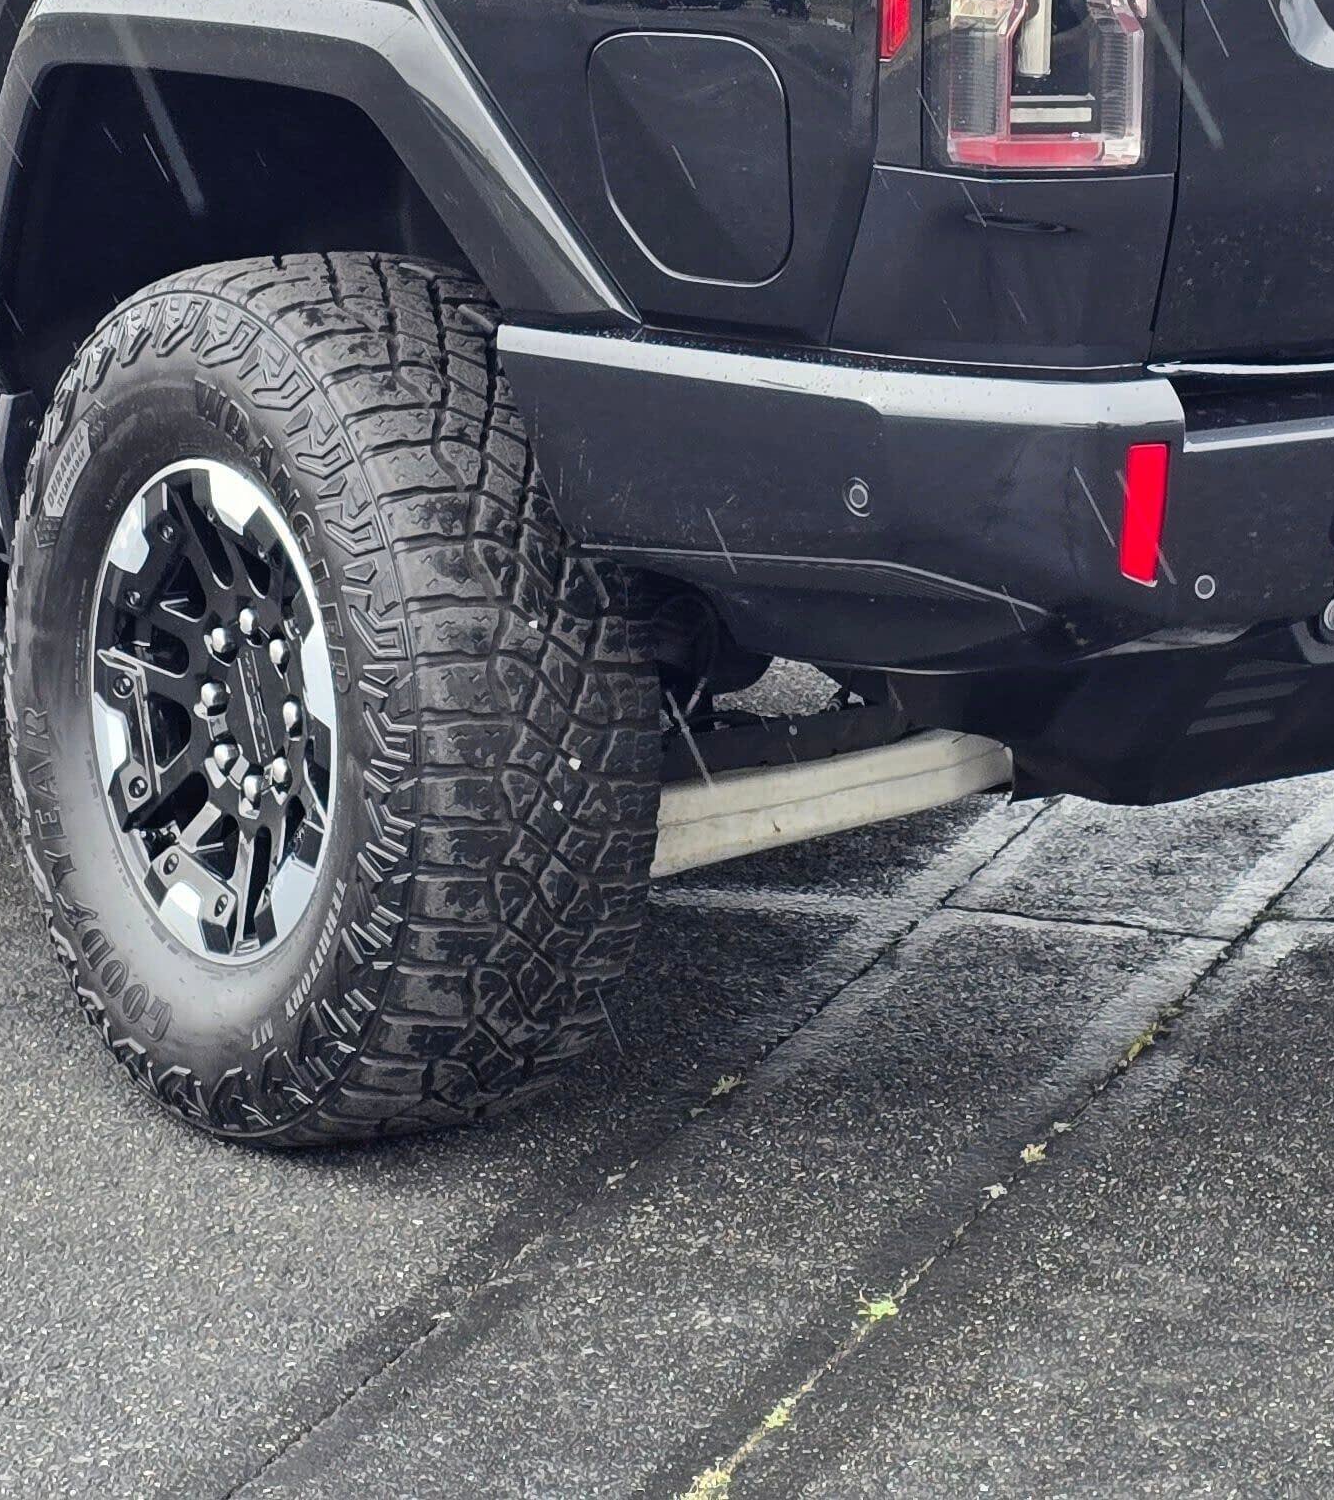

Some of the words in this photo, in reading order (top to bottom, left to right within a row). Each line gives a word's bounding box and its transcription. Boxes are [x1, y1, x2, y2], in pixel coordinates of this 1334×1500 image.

[47, 428, 85, 509] DURAWALL
[57, 449, 86, 508] TECHNOLOGY
[194, 376, 352, 693] WRANGLER
[23, 706, 173, 1043] GOODYEAR
[285, 877, 348, 1022] TERRITORY
